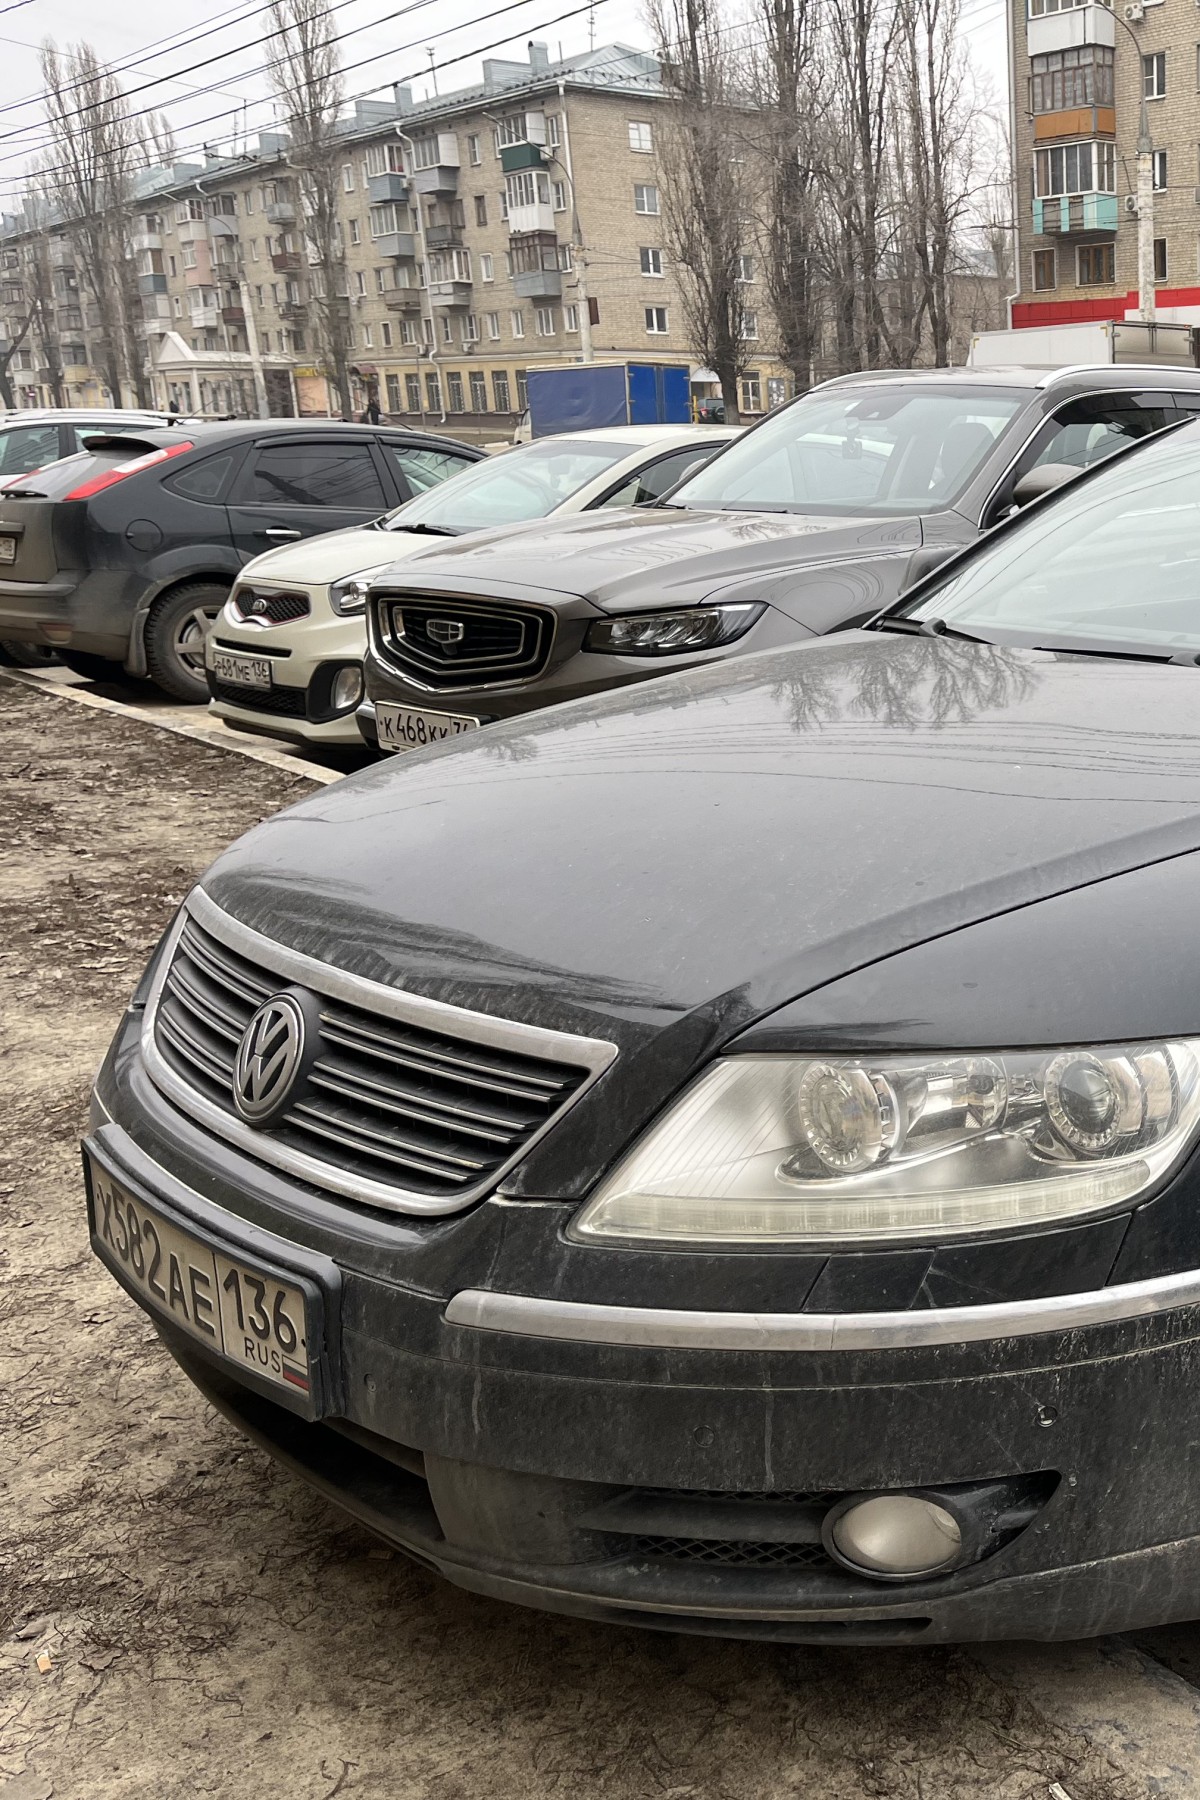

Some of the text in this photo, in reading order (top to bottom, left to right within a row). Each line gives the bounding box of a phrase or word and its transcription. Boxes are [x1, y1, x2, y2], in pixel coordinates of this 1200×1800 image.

[97, 1181, 297, 1354] Х582АЕ 136
[244, 1337, 281, 1373] RUS
